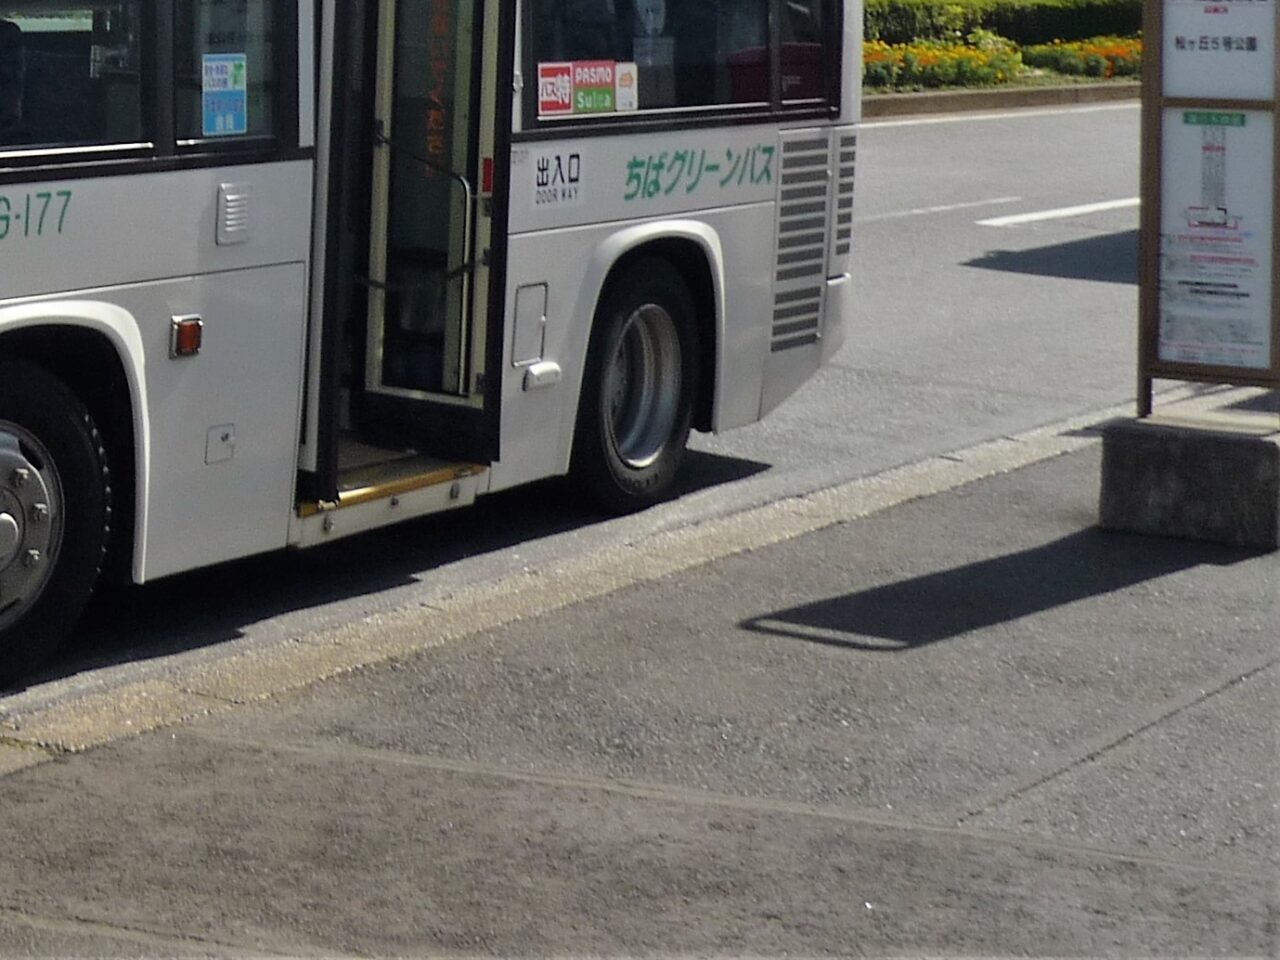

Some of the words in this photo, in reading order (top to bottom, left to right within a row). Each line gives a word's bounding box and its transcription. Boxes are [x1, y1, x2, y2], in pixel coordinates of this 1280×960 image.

[575, 66, 612, 85] PASMO
[536, 153, 581, 187] 出入口
[624, 145, 775, 201] ちばグリーンバス
